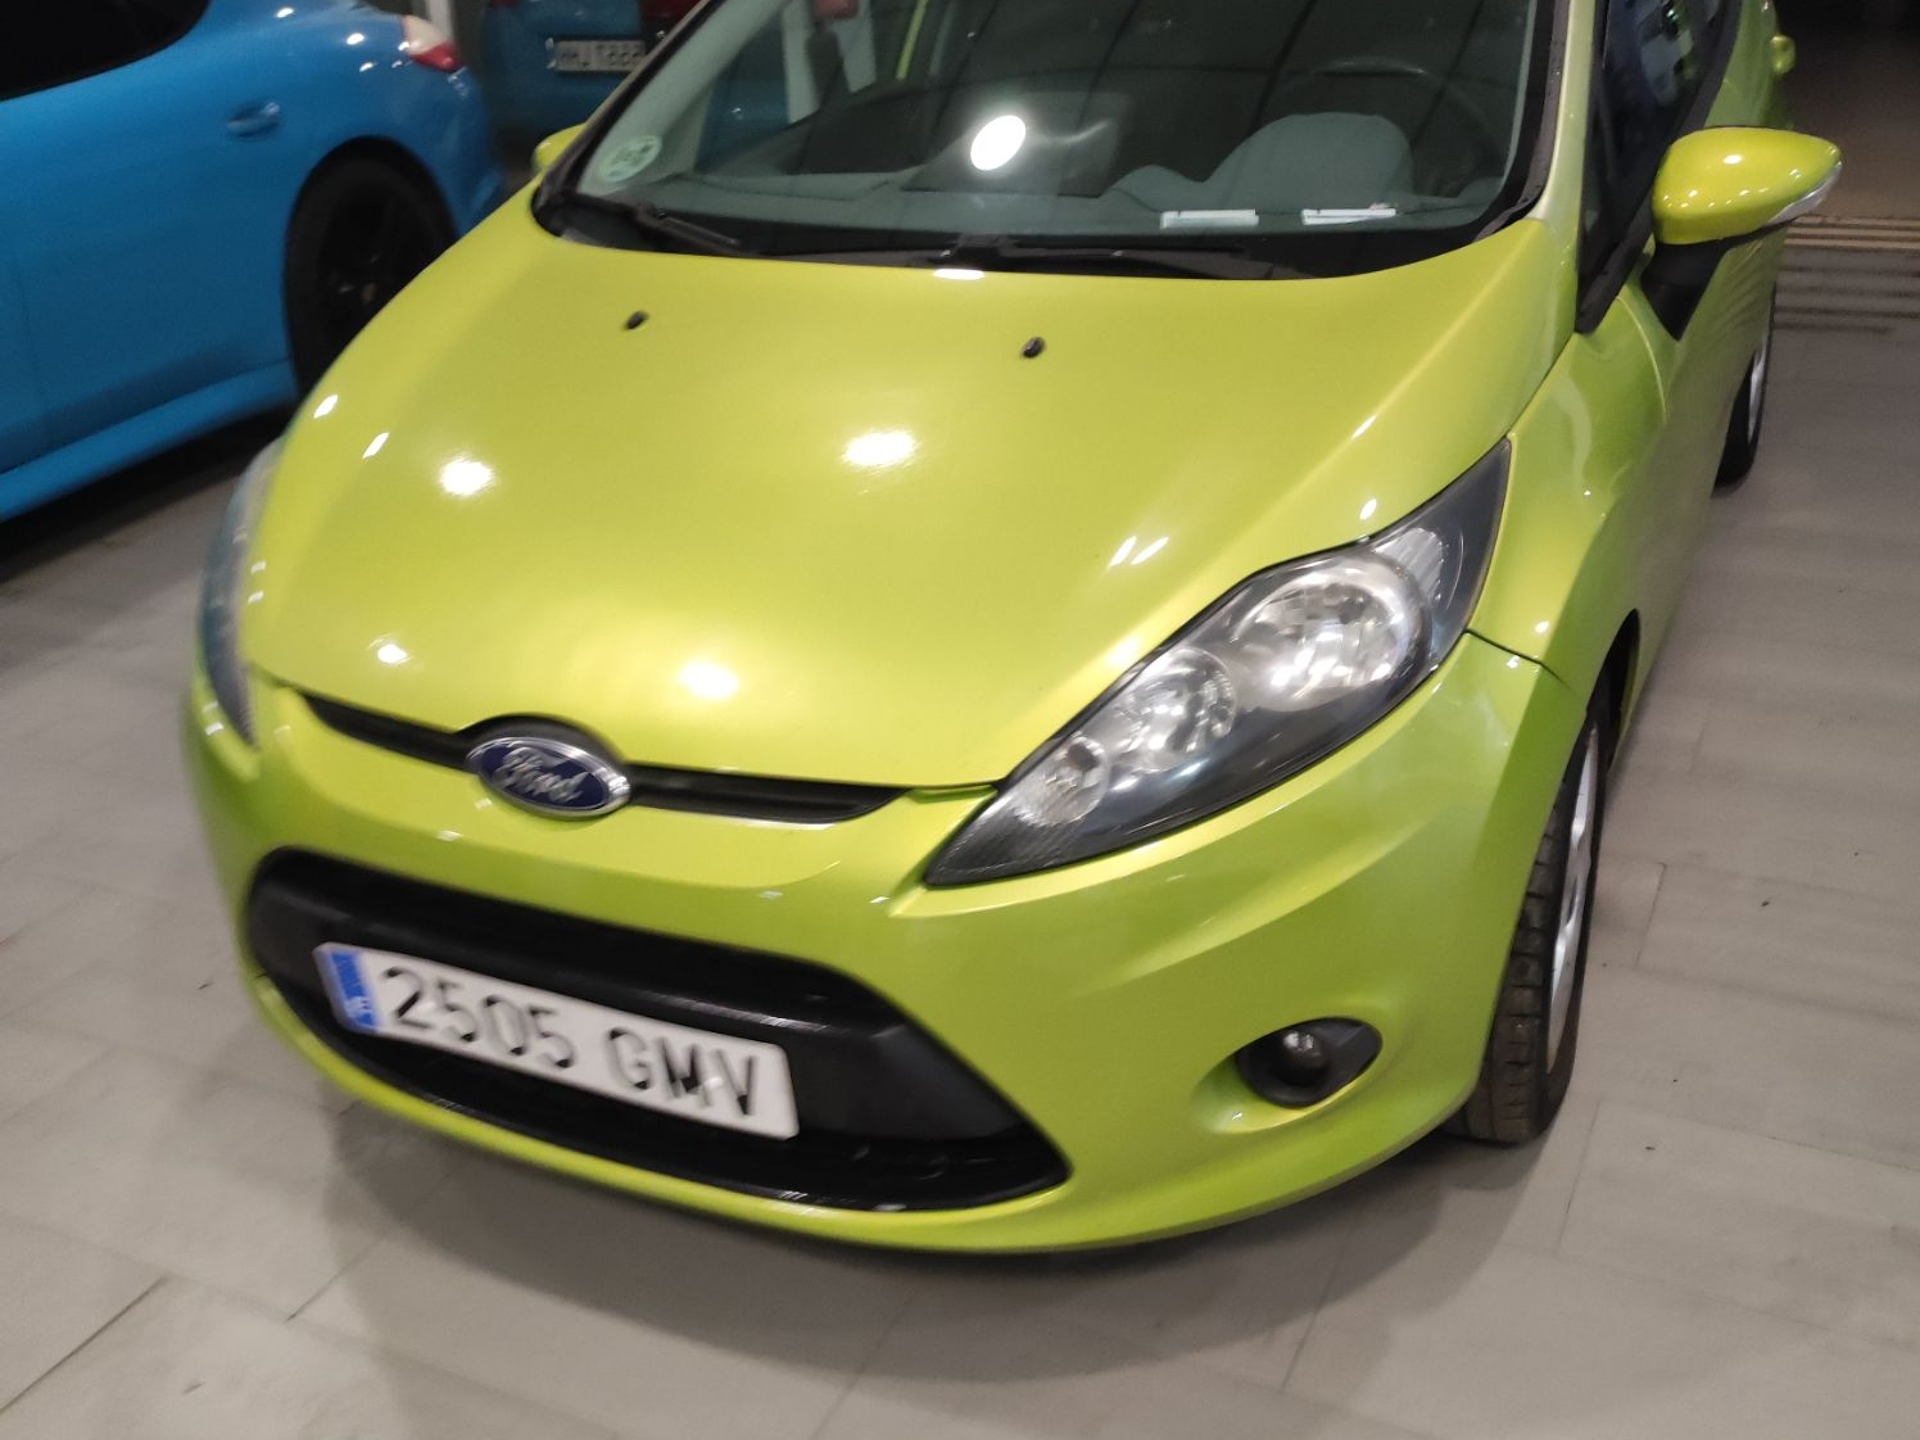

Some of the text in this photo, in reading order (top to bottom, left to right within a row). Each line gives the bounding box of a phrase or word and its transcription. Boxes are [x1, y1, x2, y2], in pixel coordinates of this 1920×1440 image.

[491, 747, 589, 803] Ford
[382, 967, 756, 1116] 2505 GMV
